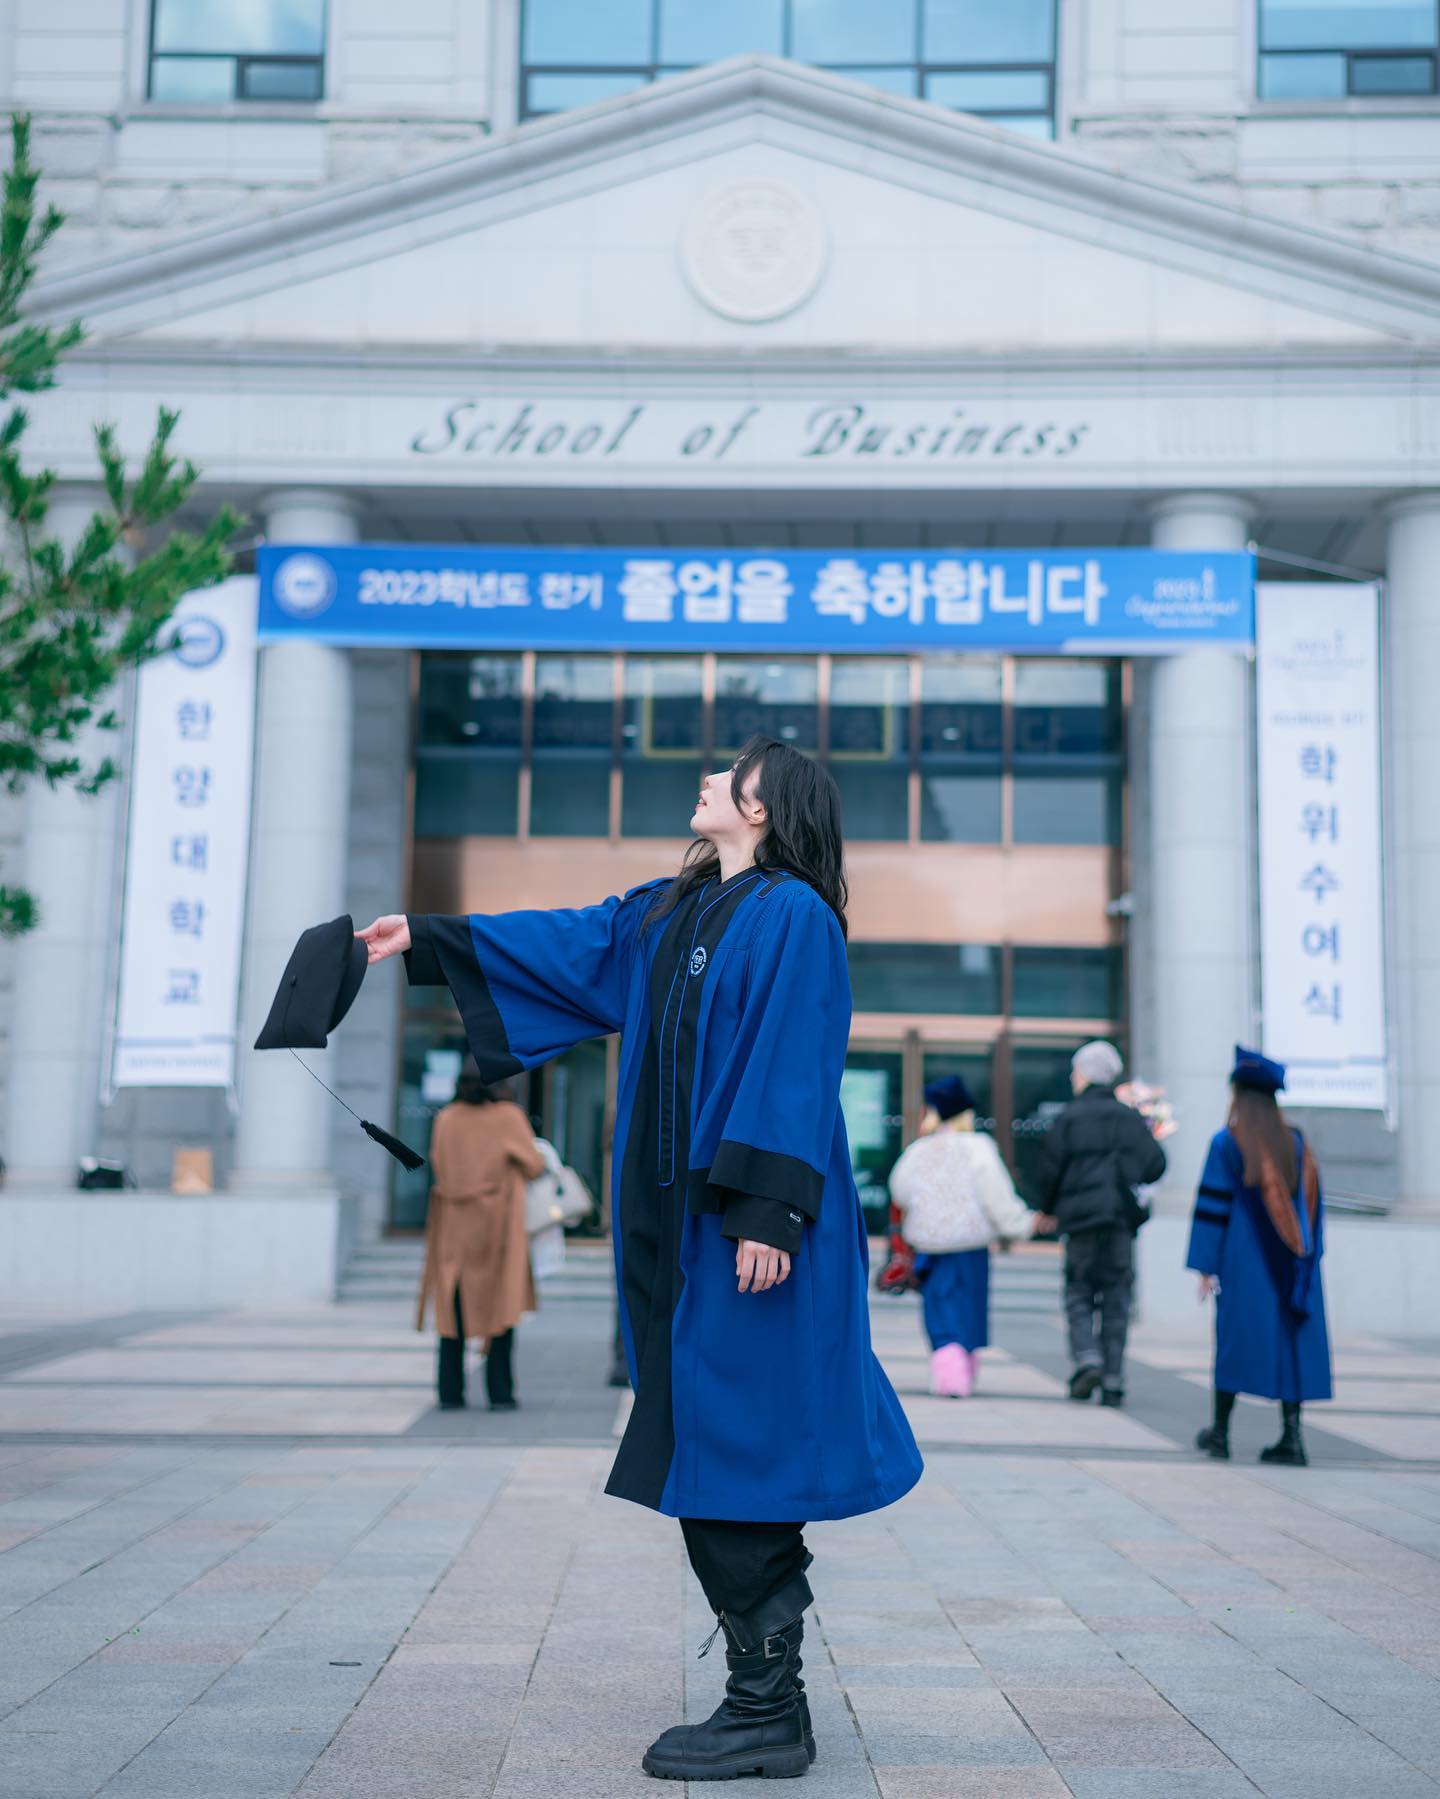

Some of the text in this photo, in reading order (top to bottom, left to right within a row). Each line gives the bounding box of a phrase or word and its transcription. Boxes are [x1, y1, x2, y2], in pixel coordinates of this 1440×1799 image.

[410, 400, 1088, 458] School of Business
[358, 569, 531, 609] 2023학년도
[618, 559, 794, 624] 졸업을
[810, 559, 1109, 627] 축하합니다
[164, 697, 213, 1006] 한양대학교
[1299, 743, 1343, 1024] 학위수여식
